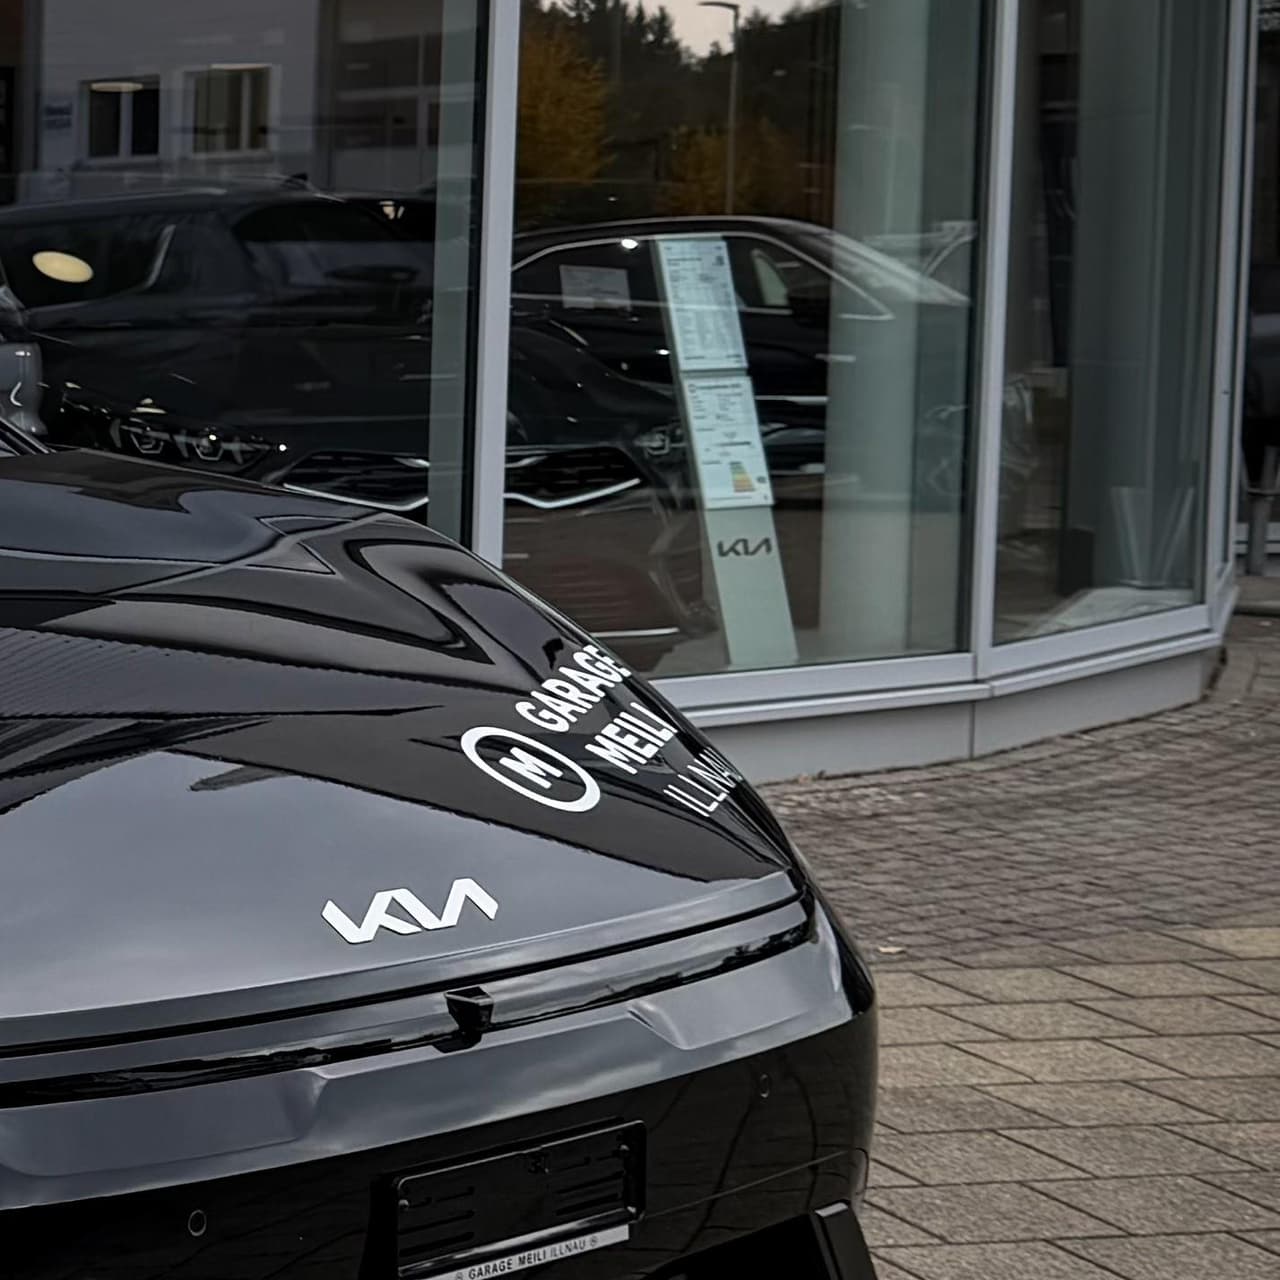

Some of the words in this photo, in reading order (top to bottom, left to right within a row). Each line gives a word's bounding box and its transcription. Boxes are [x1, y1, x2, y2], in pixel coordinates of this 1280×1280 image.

[717, 538, 773, 558] KIA
[515, 645, 632, 732] GARAGE
[585, 702, 678, 774] MEILI
[321, 877, 499, 944] KIA
[468, 1260, 513, 1280] GARAGE
[518, 1251, 547, 1267] MEILI
[550, 1239, 586, 1259] ILLNAU
